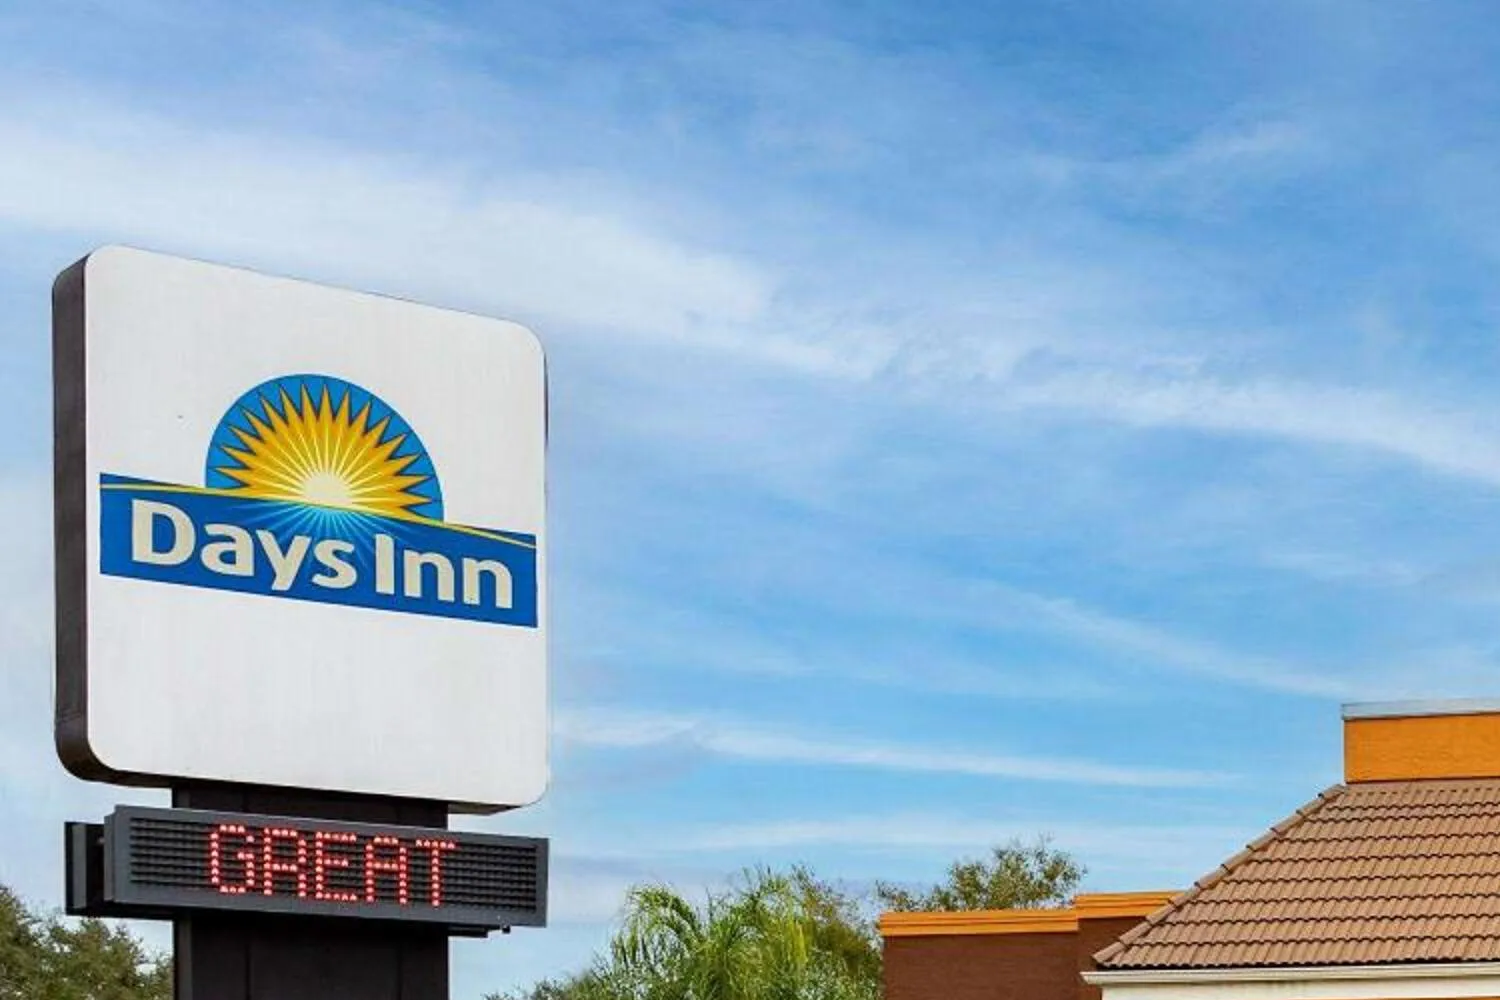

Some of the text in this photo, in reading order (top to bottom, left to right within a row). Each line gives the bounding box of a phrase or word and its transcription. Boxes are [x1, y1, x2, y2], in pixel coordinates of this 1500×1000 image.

[132, 499, 513, 609] Days Inn
[208, 823, 458, 908] GREAT
